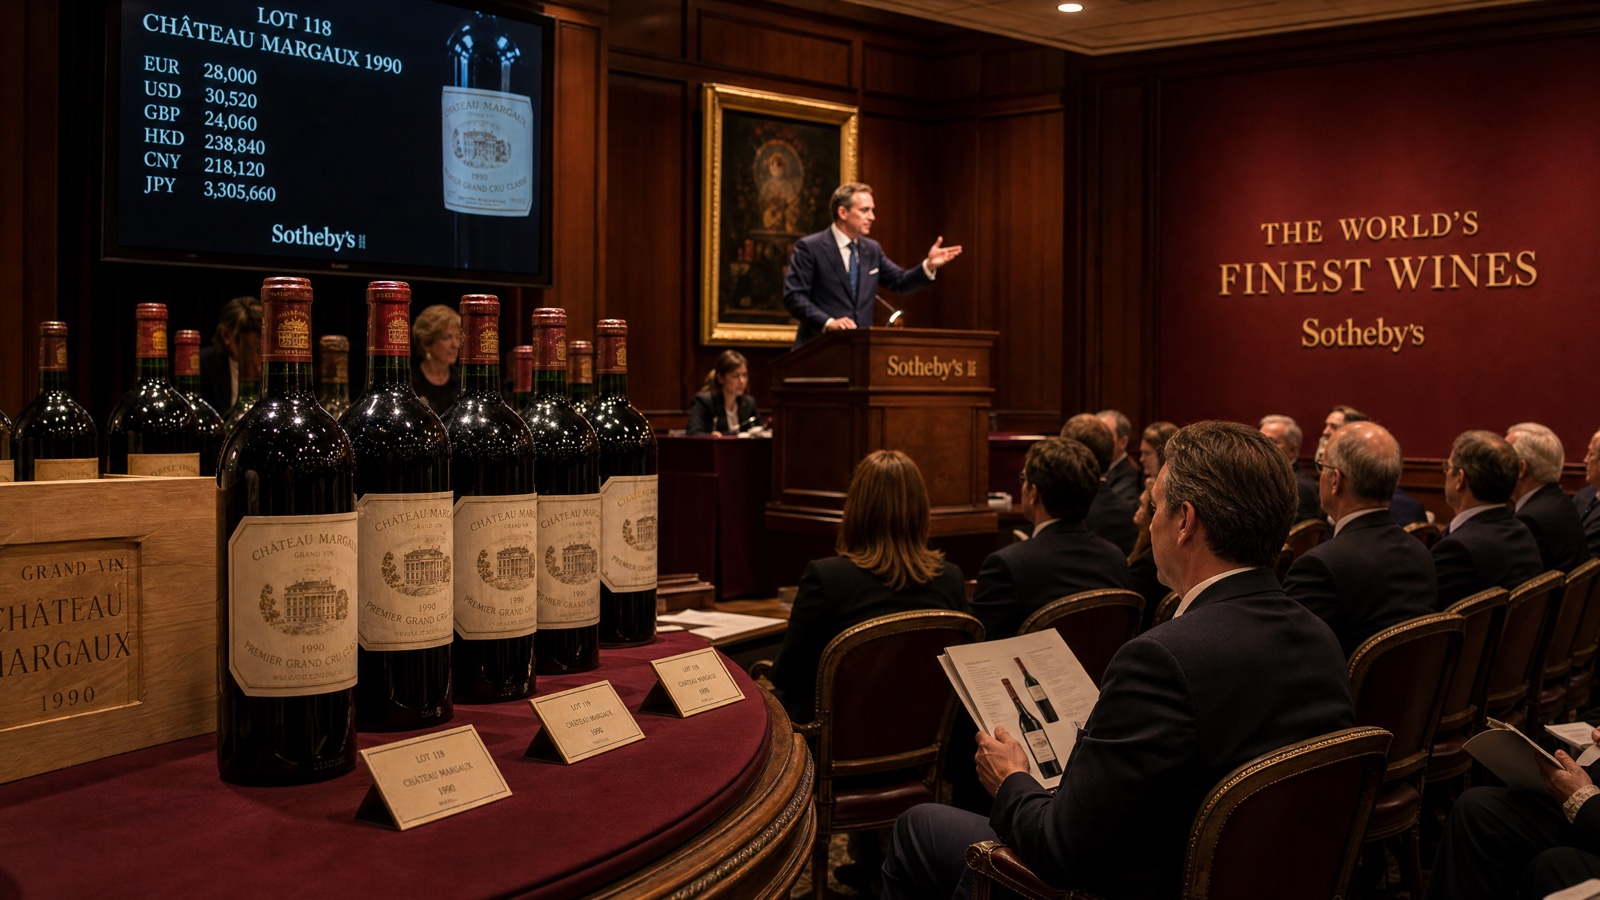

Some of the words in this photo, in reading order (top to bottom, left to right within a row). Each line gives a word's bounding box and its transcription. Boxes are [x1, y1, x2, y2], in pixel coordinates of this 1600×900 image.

[257, 6, 298, 30] LOT
[303, 16, 332, 37] 118
[142, 12, 255, 48] CHÂTEAU
[260, 33, 360, 68] MARGAUX
[365, 54, 402, 75] 1990
[143, 55, 180, 75] EUR
[203, 63, 258, 86] 28,000
[144, 81, 181, 99] USD
[204, 88, 258, 109] 30,520
[144, 104, 181, 122] GBP
[203, 111, 258, 132] 24,060
[483, 101, 527, 129] MARGAUX
[144, 128, 185, 146] HKD
[204, 134, 266, 156] 238,840
[144, 151, 181, 170] CNY
[204, 157, 265, 178] 218,120
[144, 175, 176, 194] JPY
[203, 181, 276, 203] 3,305,660
[489, 184, 505, 193] CRU
[271, 223, 356, 252] Sotheby's
[1260, 220, 1324, 246] THE
[1338, 210, 1480, 242] WORLD'S
[1218, 257, 1372, 296] FINEST
[1385, 250, 1539, 291] WINES
[1301, 318, 1426, 353] Sotheby's
[887, 355, 963, 381] Sotheby's
[293, 551, 321, 559] GRAND
[21, 561, 87, 581] GRAND
[98, 558, 125, 573] VIN
[419, 603, 436, 612] 1990
[463, 595, 496, 615] PREMIER
[498, 608, 524, 617] GRAND
[537, 590, 562, 607] REMIER
[365, 601, 403, 623] PREMIER
[405, 616, 435, 625] GRAND
[244, 640, 283, 666] PREMIER
[286, 658, 322, 669] GRAND
[325, 653, 342, 666] CRU
[302, 643, 325, 654] 1990
[41, 686, 96, 712] 1990
[570, 702, 582, 711] LOT
[415, 753, 431, 764] LOT
[432, 750, 446, 760] 118
[438, 762, 474, 778] MARGAUX
[438, 784, 456, 796] 1990
